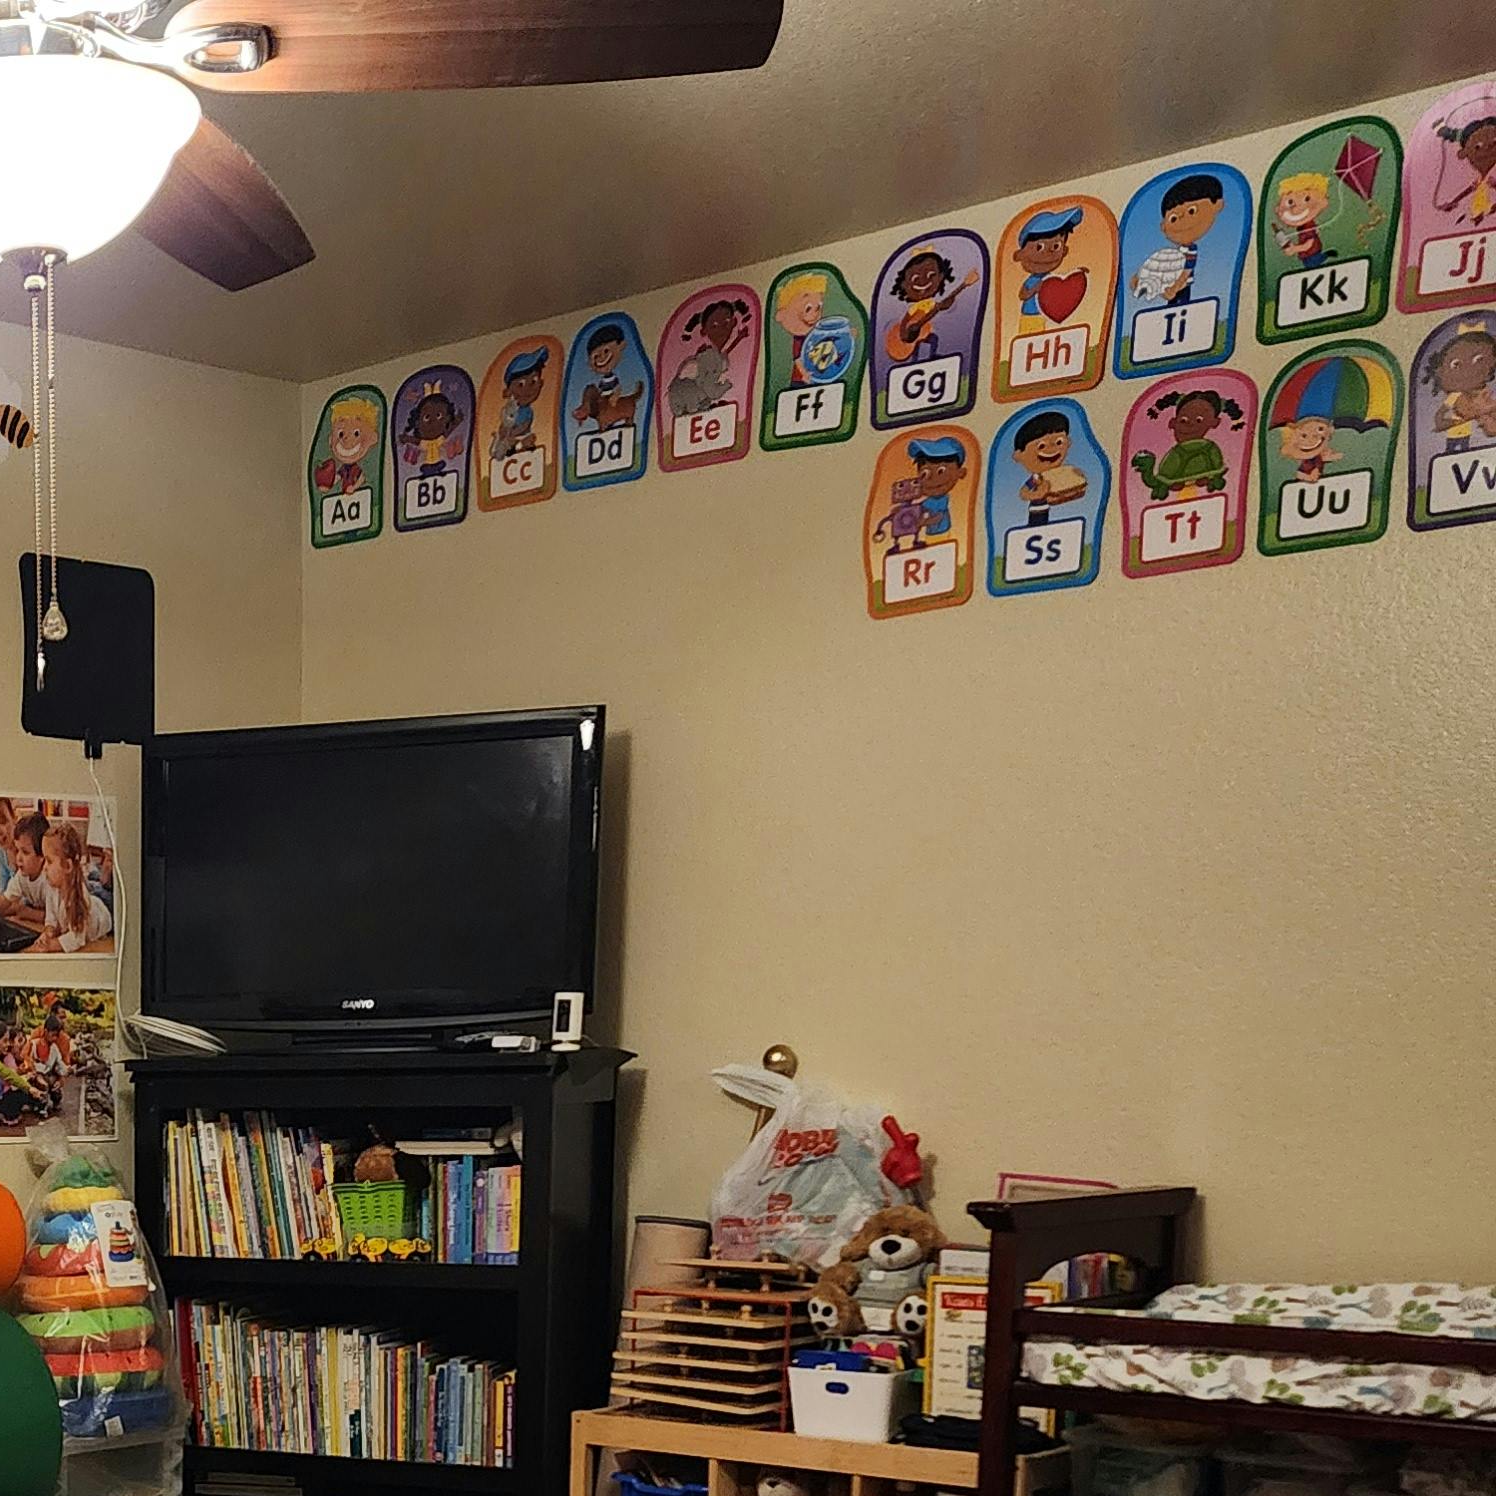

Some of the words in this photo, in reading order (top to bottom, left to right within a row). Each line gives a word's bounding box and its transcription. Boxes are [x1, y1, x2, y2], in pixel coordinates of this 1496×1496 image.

[1448, 237, 1487, 283] Jj
[1299, 270, 1350, 309] Kk
[1163, 314, 1188, 346] Ii
[1025, 335, 1071, 372] Hh
[901, 367, 948, 402] Gg
[794, 393, 825, 423] Ff
[689, 414, 722, 444] Ee
[587, 436, 623, 465] Dd
[502, 459, 533, 484] Cc
[416, 481, 447, 508] Bb
[1296, 485, 1352, 520] Uu
[330, 499, 361, 525] Aa
[1164, 511, 1201, 543] Tt
[1024, 535, 1062, 565] Ss
[903, 557, 936, 587] Rr
